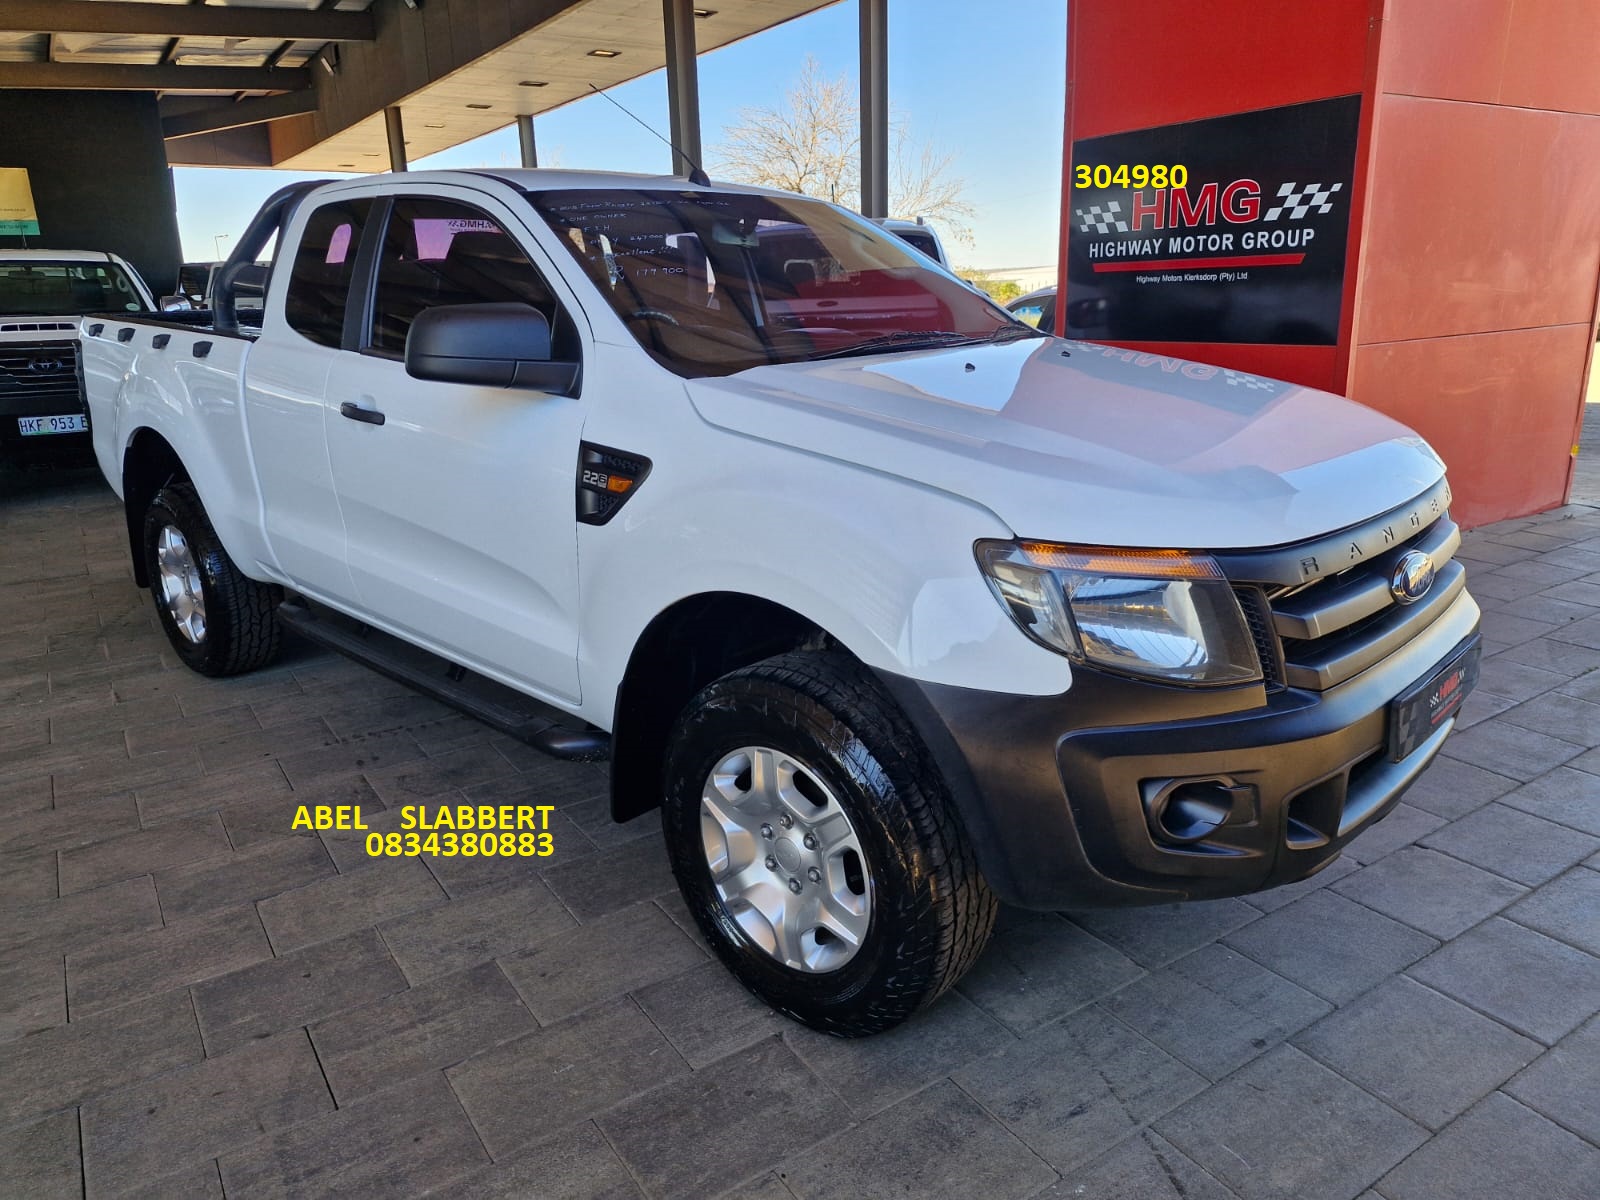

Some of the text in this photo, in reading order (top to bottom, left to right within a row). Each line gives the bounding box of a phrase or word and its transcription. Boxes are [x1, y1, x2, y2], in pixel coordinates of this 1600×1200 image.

[1132, 179, 1261, 231] HMG
[1089, 228, 1315, 258] HIGHWAY MOTOR GROUP
[1136, 276, 1161, 284] Highway
[1162, 274, 1183, 282] Motors
[1219, 272, 1235, 281] (Pty)
[20, 419, 44, 433] HKF
[50, 416, 75, 431] 953
